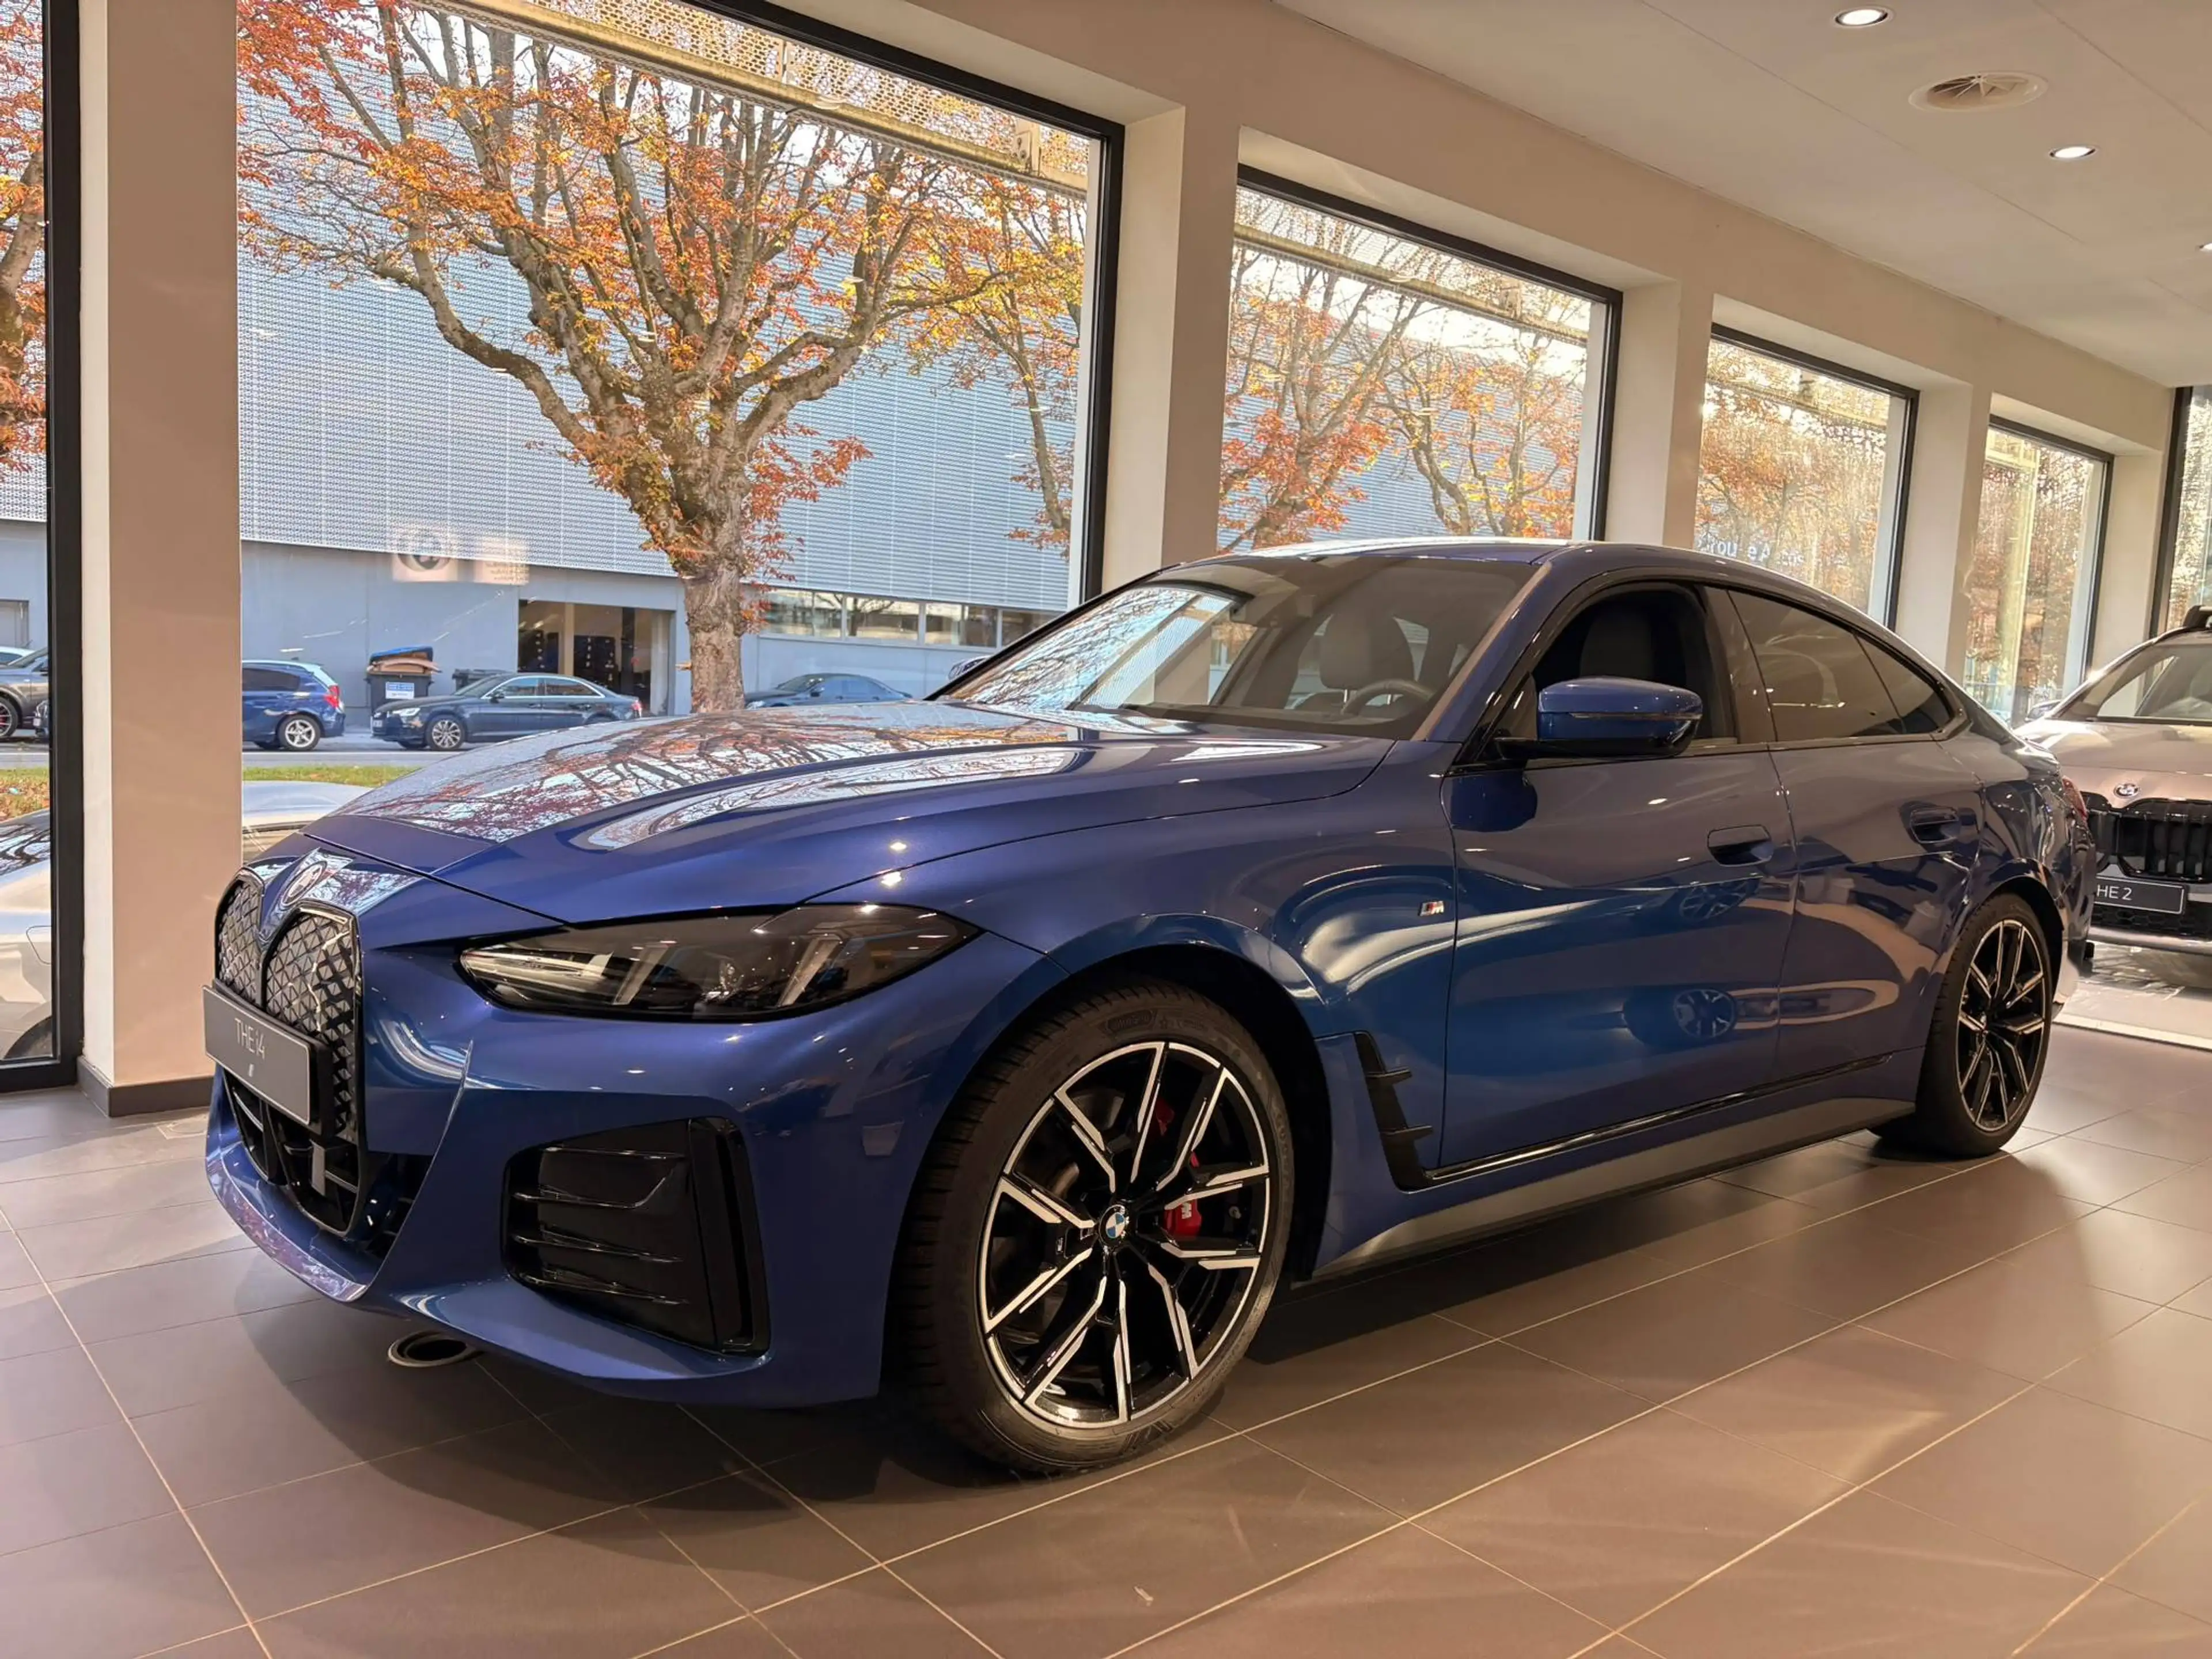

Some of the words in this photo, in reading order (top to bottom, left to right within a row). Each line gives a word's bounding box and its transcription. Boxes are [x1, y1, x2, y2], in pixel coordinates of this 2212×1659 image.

[2096, 884, 2119, 899] HE
[2122, 887, 2133, 900] 2
[234, 1017, 255, 1053] THE
[255, 1029, 265, 1059] i4
